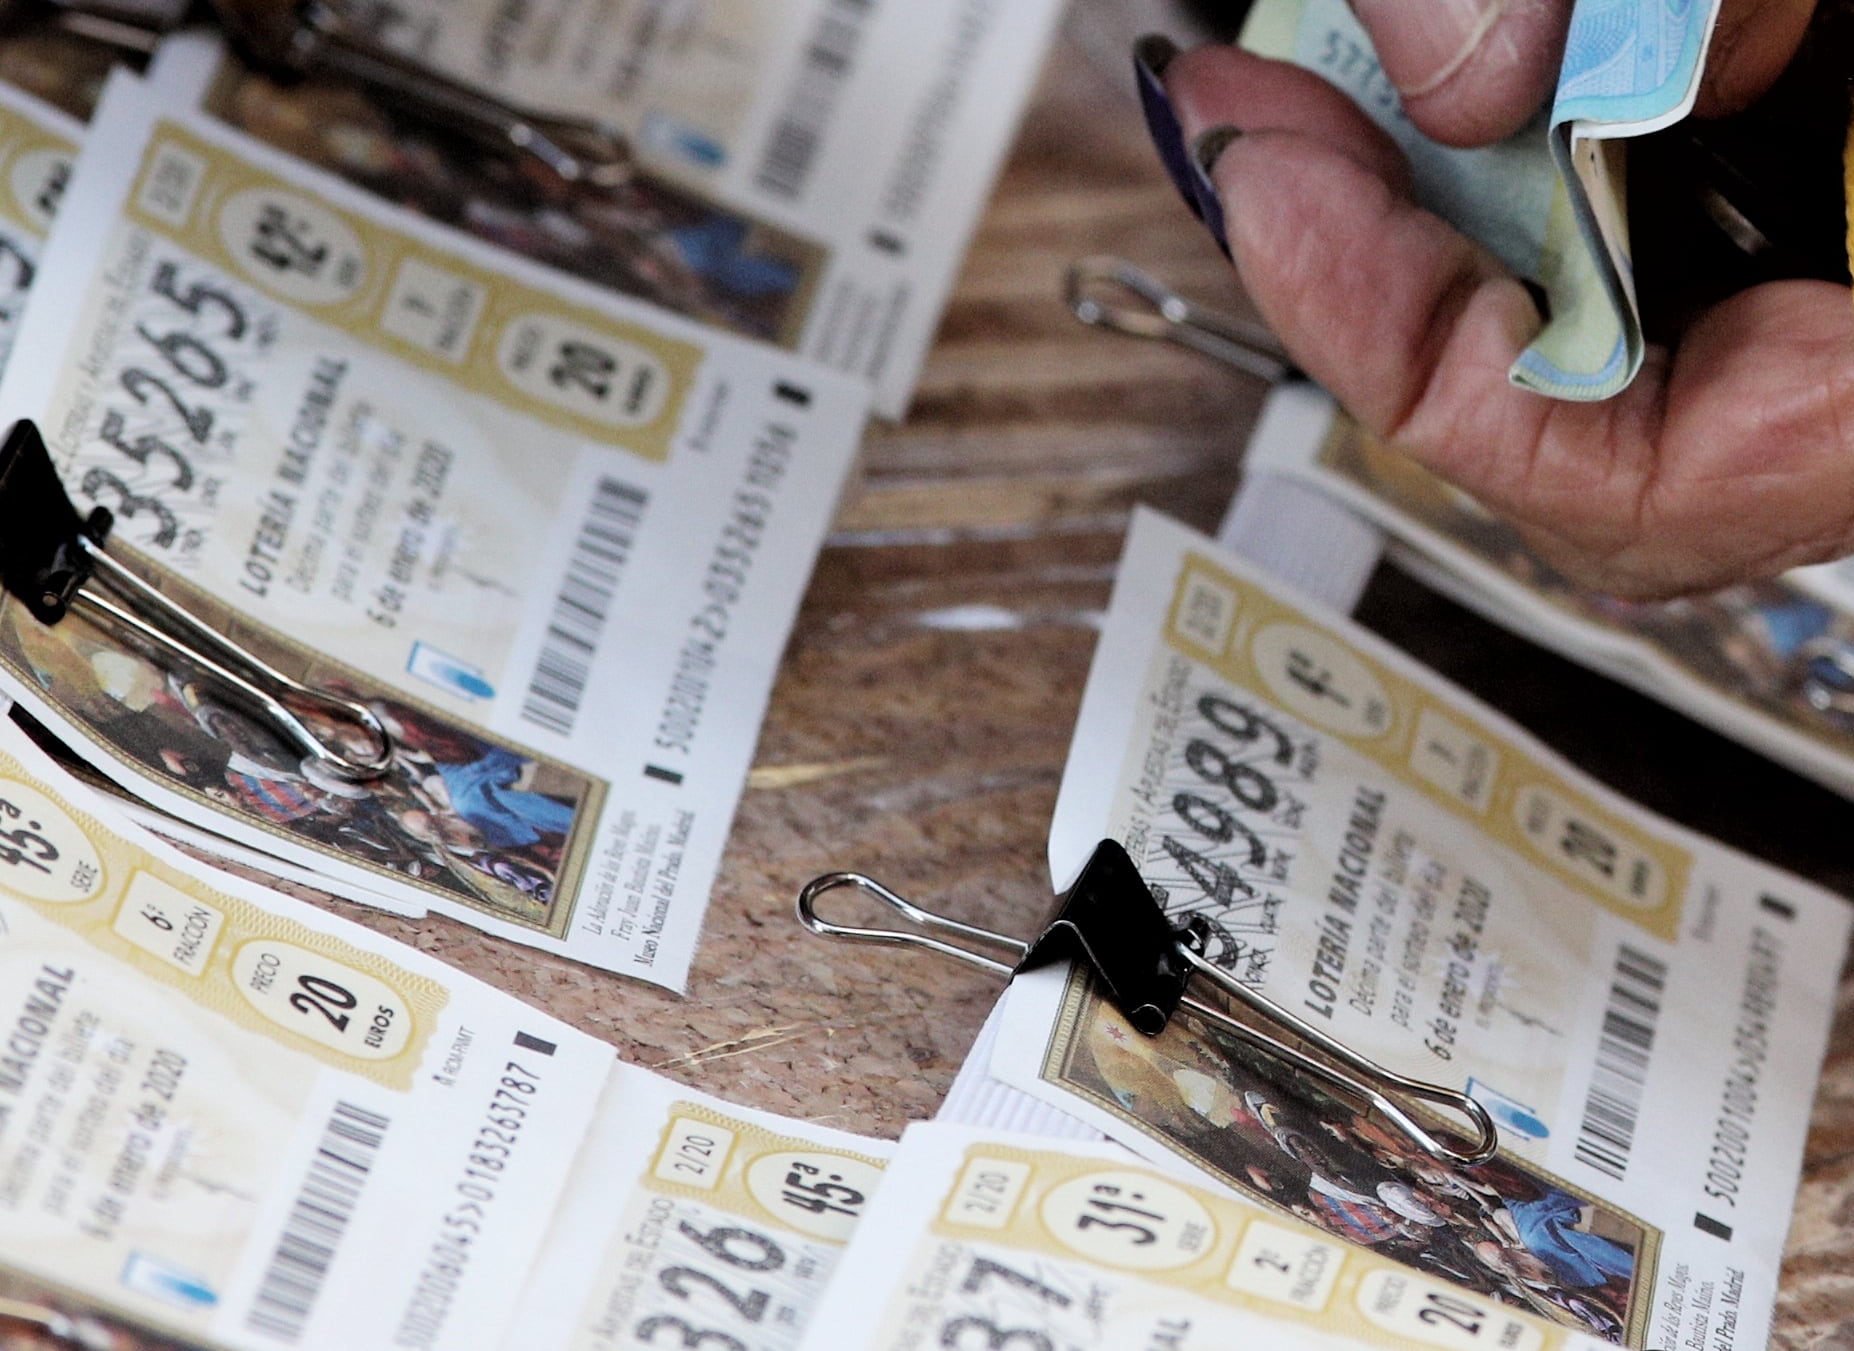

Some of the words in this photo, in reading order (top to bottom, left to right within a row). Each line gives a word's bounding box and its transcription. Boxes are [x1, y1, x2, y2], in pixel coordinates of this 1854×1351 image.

[549, 342, 617, 400] 20
[81, 262, 247, 550] 35265
[277, 358, 348, 484] NACIONAL
[1150, 695, 1293, 971] 54989
[1327, 787, 1387, 915] NACIONAL
[1559, 820, 1618, 879] 20
[70, 859, 99, 893] SERIE
[653, 879, 675, 898] del
[609, 917, 639, 942] Fray
[616, 894, 642, 919] Juan
[640, 894, 671, 940] Nacional
[1452, 876, 1492, 936] 2020
[172, 905, 212, 964] FRACCIÓN
[632, 938, 659, 968] Museo
[1445, 931, 1479, 963] de
[249, 952, 282, 992] PRECIO
[1303, 913, 1352, 1021] LOTERÍA
[1347, 958, 1382, 1018] Décima
[1365, 914, 1393, 962] parte
[1438, 961, 1471, 1020] enero
[288, 974, 358, 1033] 20
[364, 1004, 395, 1049] EUROS
[1389, 989, 1414, 1030] para
[0, 964, 75, 1096] NACIONAL
[1423, 1037, 1453, 1062] 6
[1428, 1017, 1458, 1047] de
[140, 1048, 188, 1102] 2020
[673, 1134, 716, 1176] 2/20
[636, 1219, 786, 1351] 326
[1418, 1291, 1486, 1336] 20
[1684, 1312, 1710, 1351] Bautista
